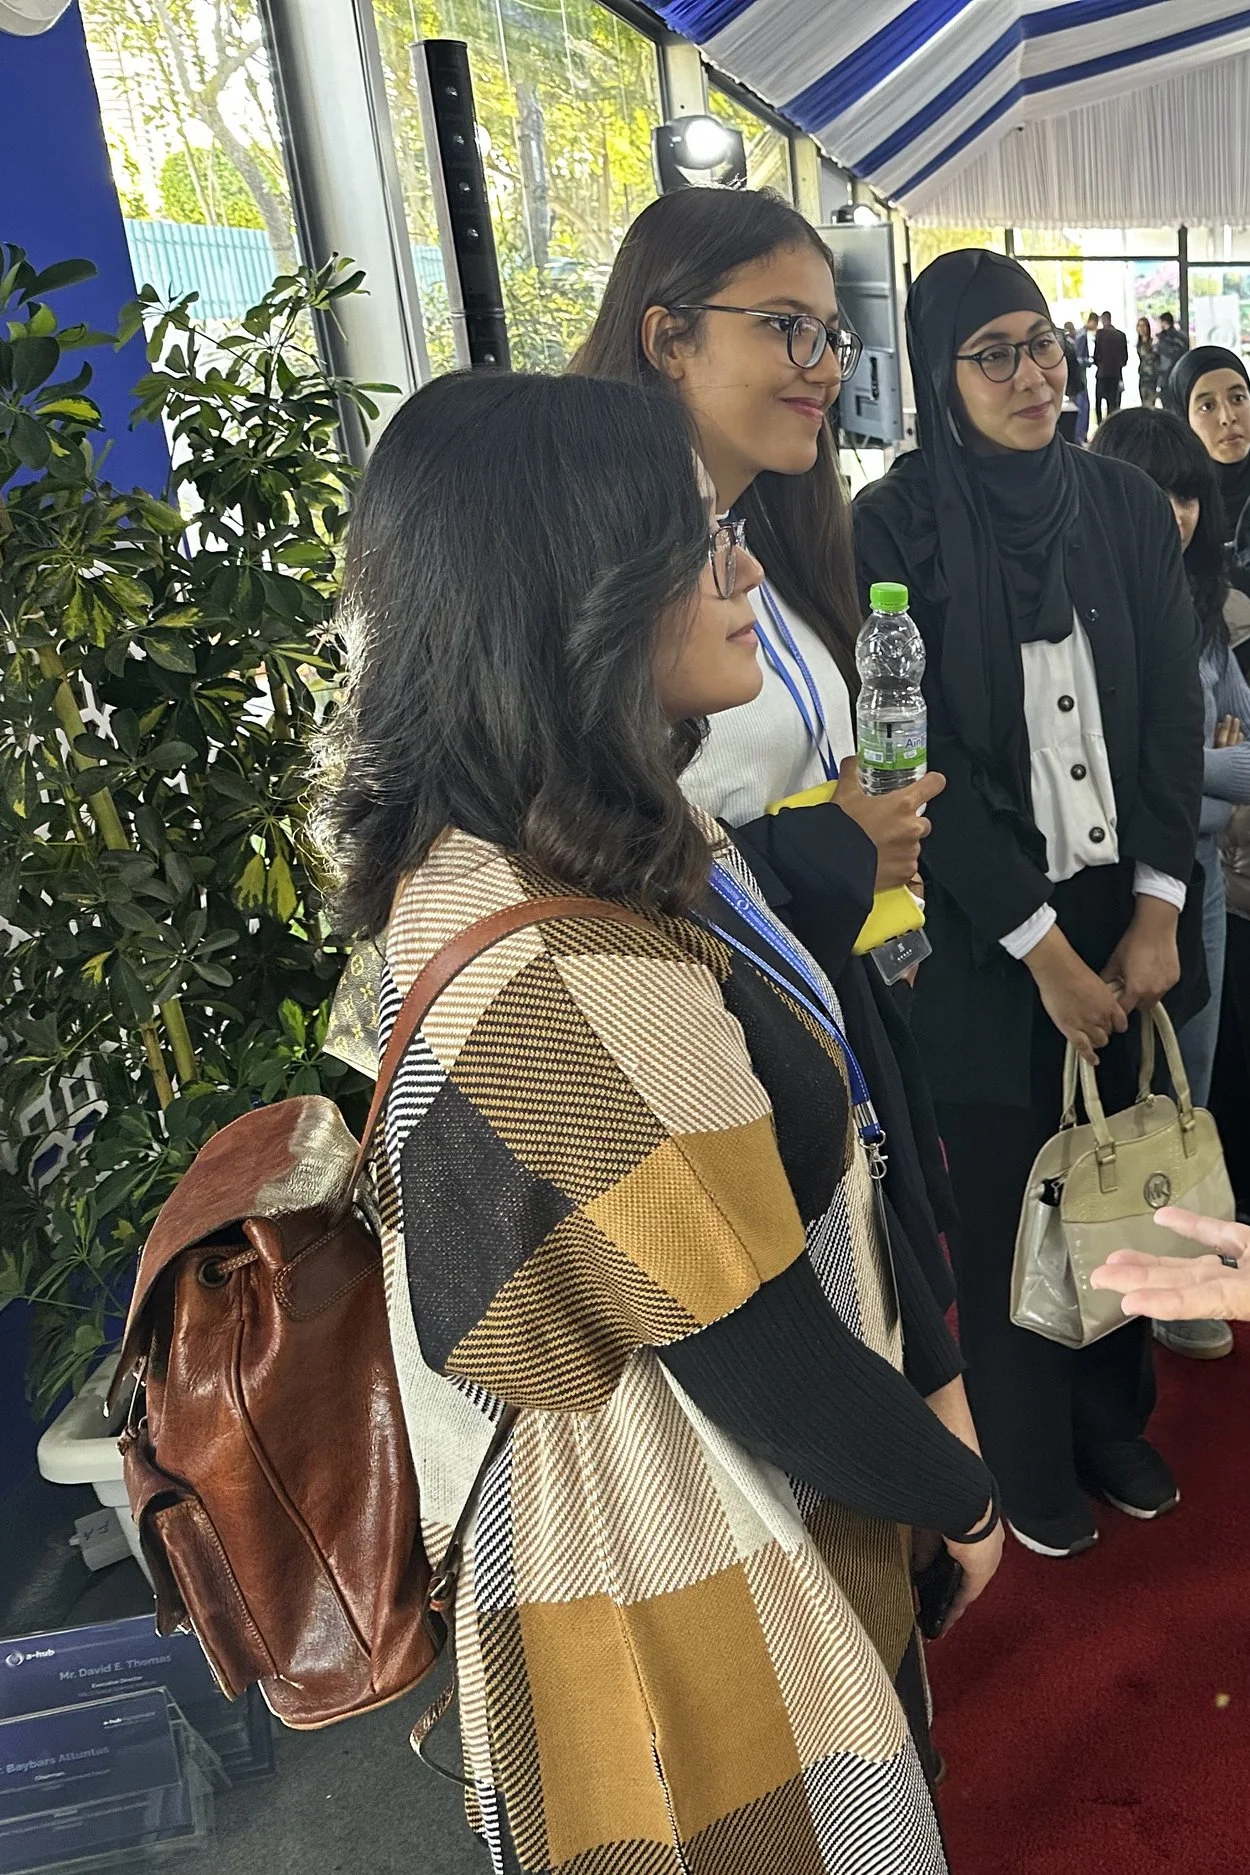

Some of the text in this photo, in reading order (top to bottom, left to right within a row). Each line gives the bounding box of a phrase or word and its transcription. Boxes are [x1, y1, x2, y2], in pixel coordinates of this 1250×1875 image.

[58, 1654, 172, 1681] Mr. David E. Thomas
[6, 1757, 57, 1775] Baybars
